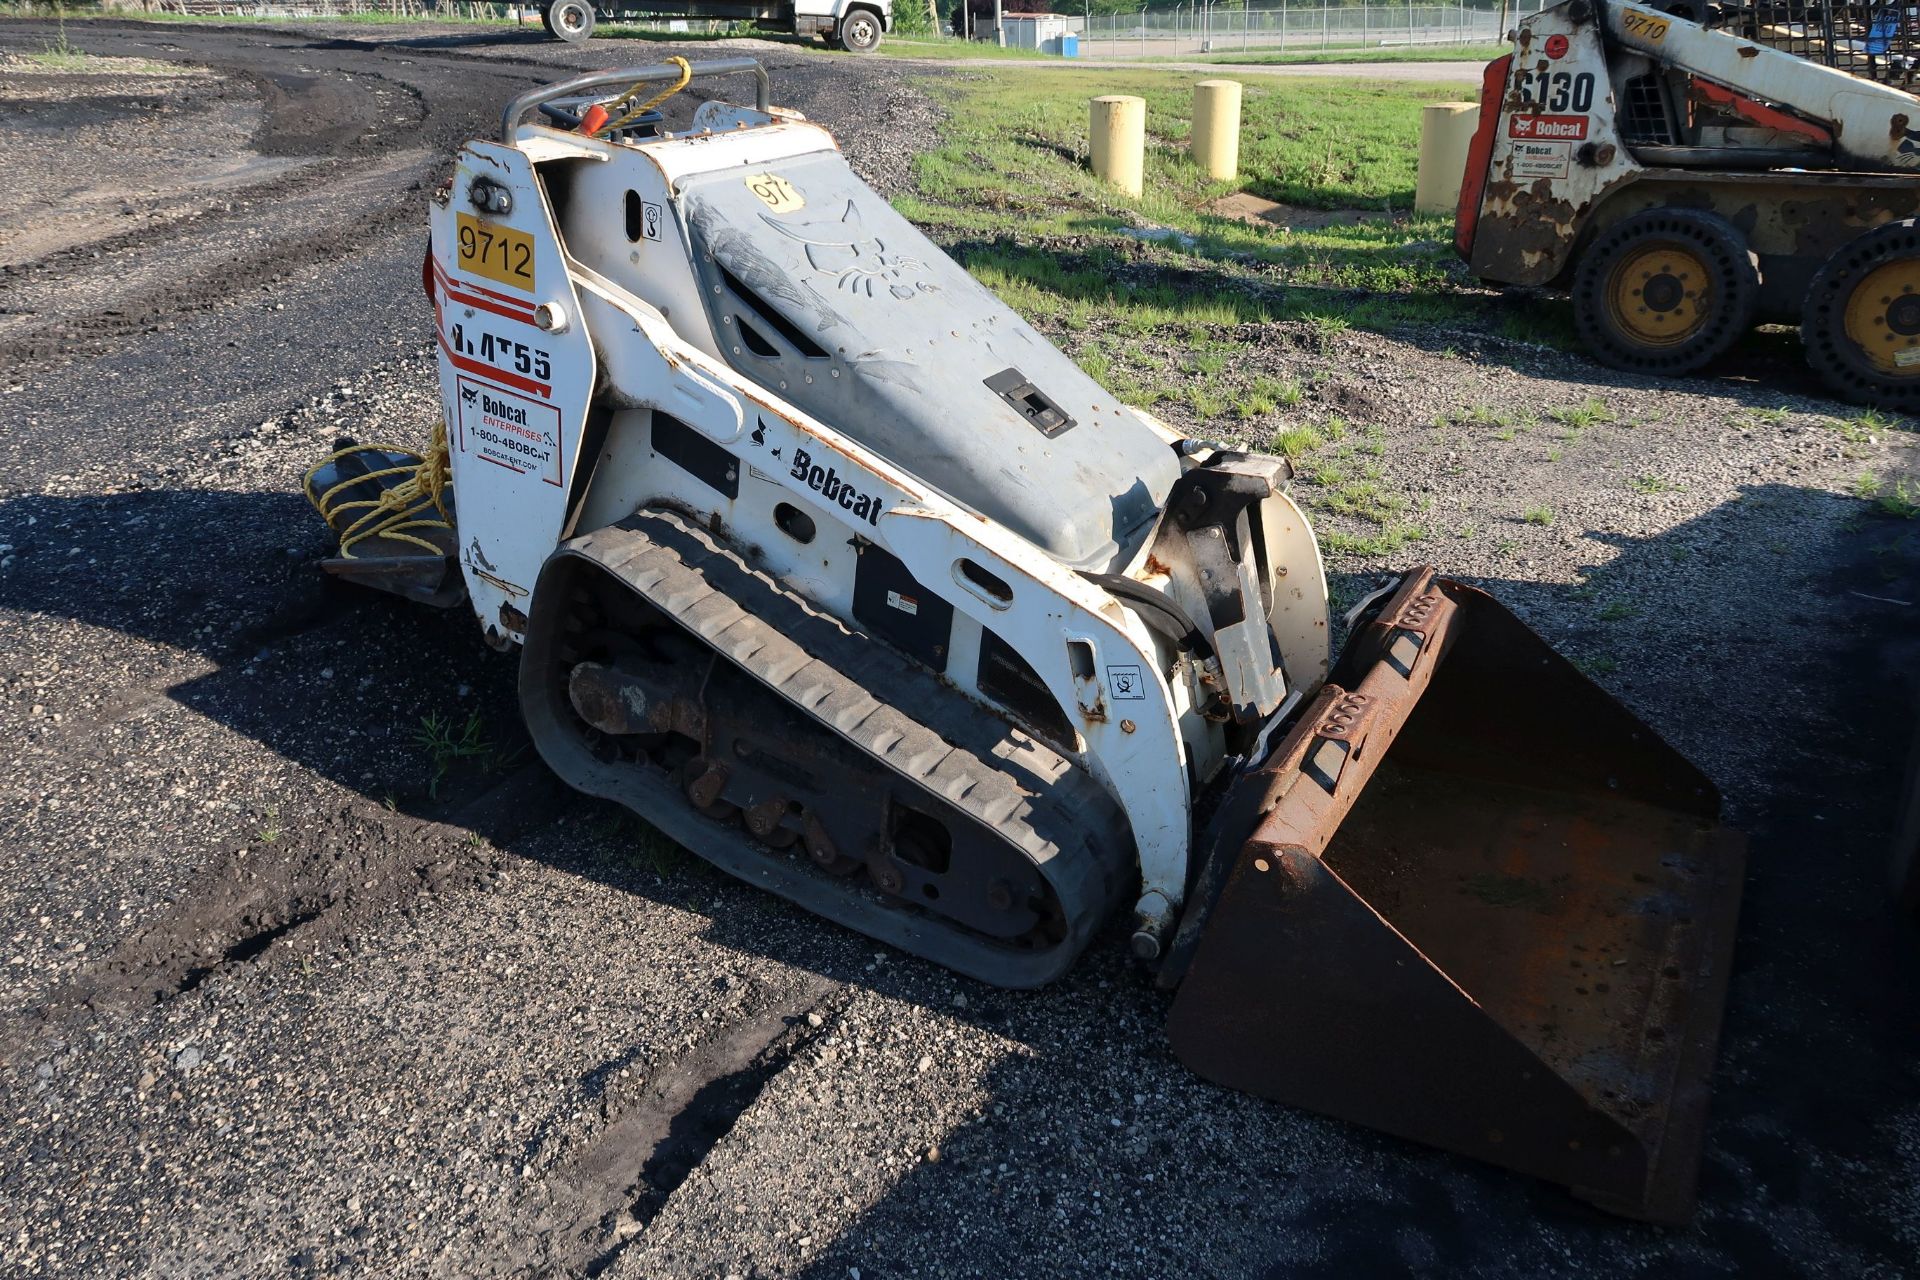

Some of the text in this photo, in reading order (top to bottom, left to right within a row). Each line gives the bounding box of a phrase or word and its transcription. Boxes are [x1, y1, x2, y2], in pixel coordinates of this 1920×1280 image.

[1623, 14, 1666, 39] 9710
[1535, 120, 1581, 136] Bobcat
[1526, 145, 1552, 155] Bobcat
[752, 179, 790, 205] 97
[460, 225, 531, 278] 9712
[482, 394, 527, 426] Bobcat
[483, 415, 542, 443] ENTERPRISES
[470, 426, 550, 462] 1-800-4BOBCAT
[790, 447, 882, 526] Bobcat
